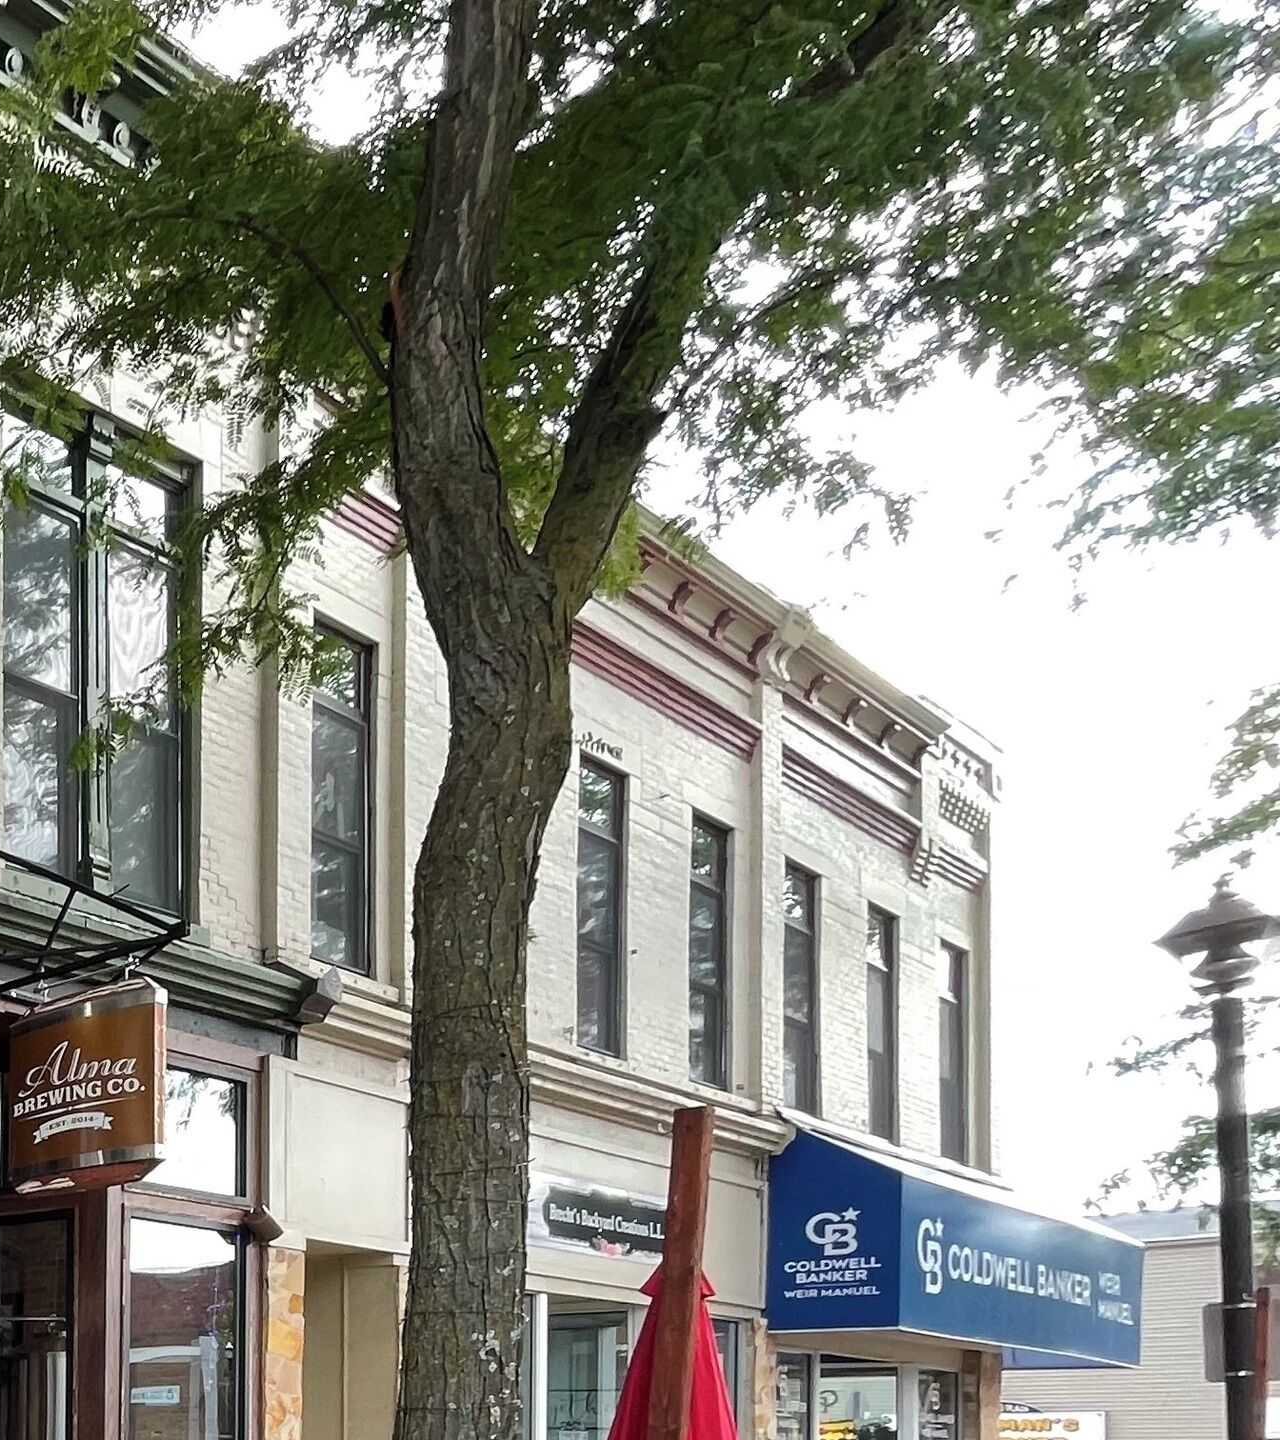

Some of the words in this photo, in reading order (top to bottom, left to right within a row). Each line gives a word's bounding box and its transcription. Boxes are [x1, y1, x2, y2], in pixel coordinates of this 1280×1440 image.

[17, 1040, 138, 1098] Alma
[13, 1080, 103, 1118] BREWING
[106, 1077, 146, 1095] CO.
[784, 1256, 882, 1273] COLDWELL
[795, 1269, 868, 1284] BANKER
[948, 1244, 1035, 1295] COLDWELL
[1037, 1264, 1091, 1307] BANKER
[784, 1288, 819, 1299] WEIR
[820, 1285, 881, 1297] MANUEL
